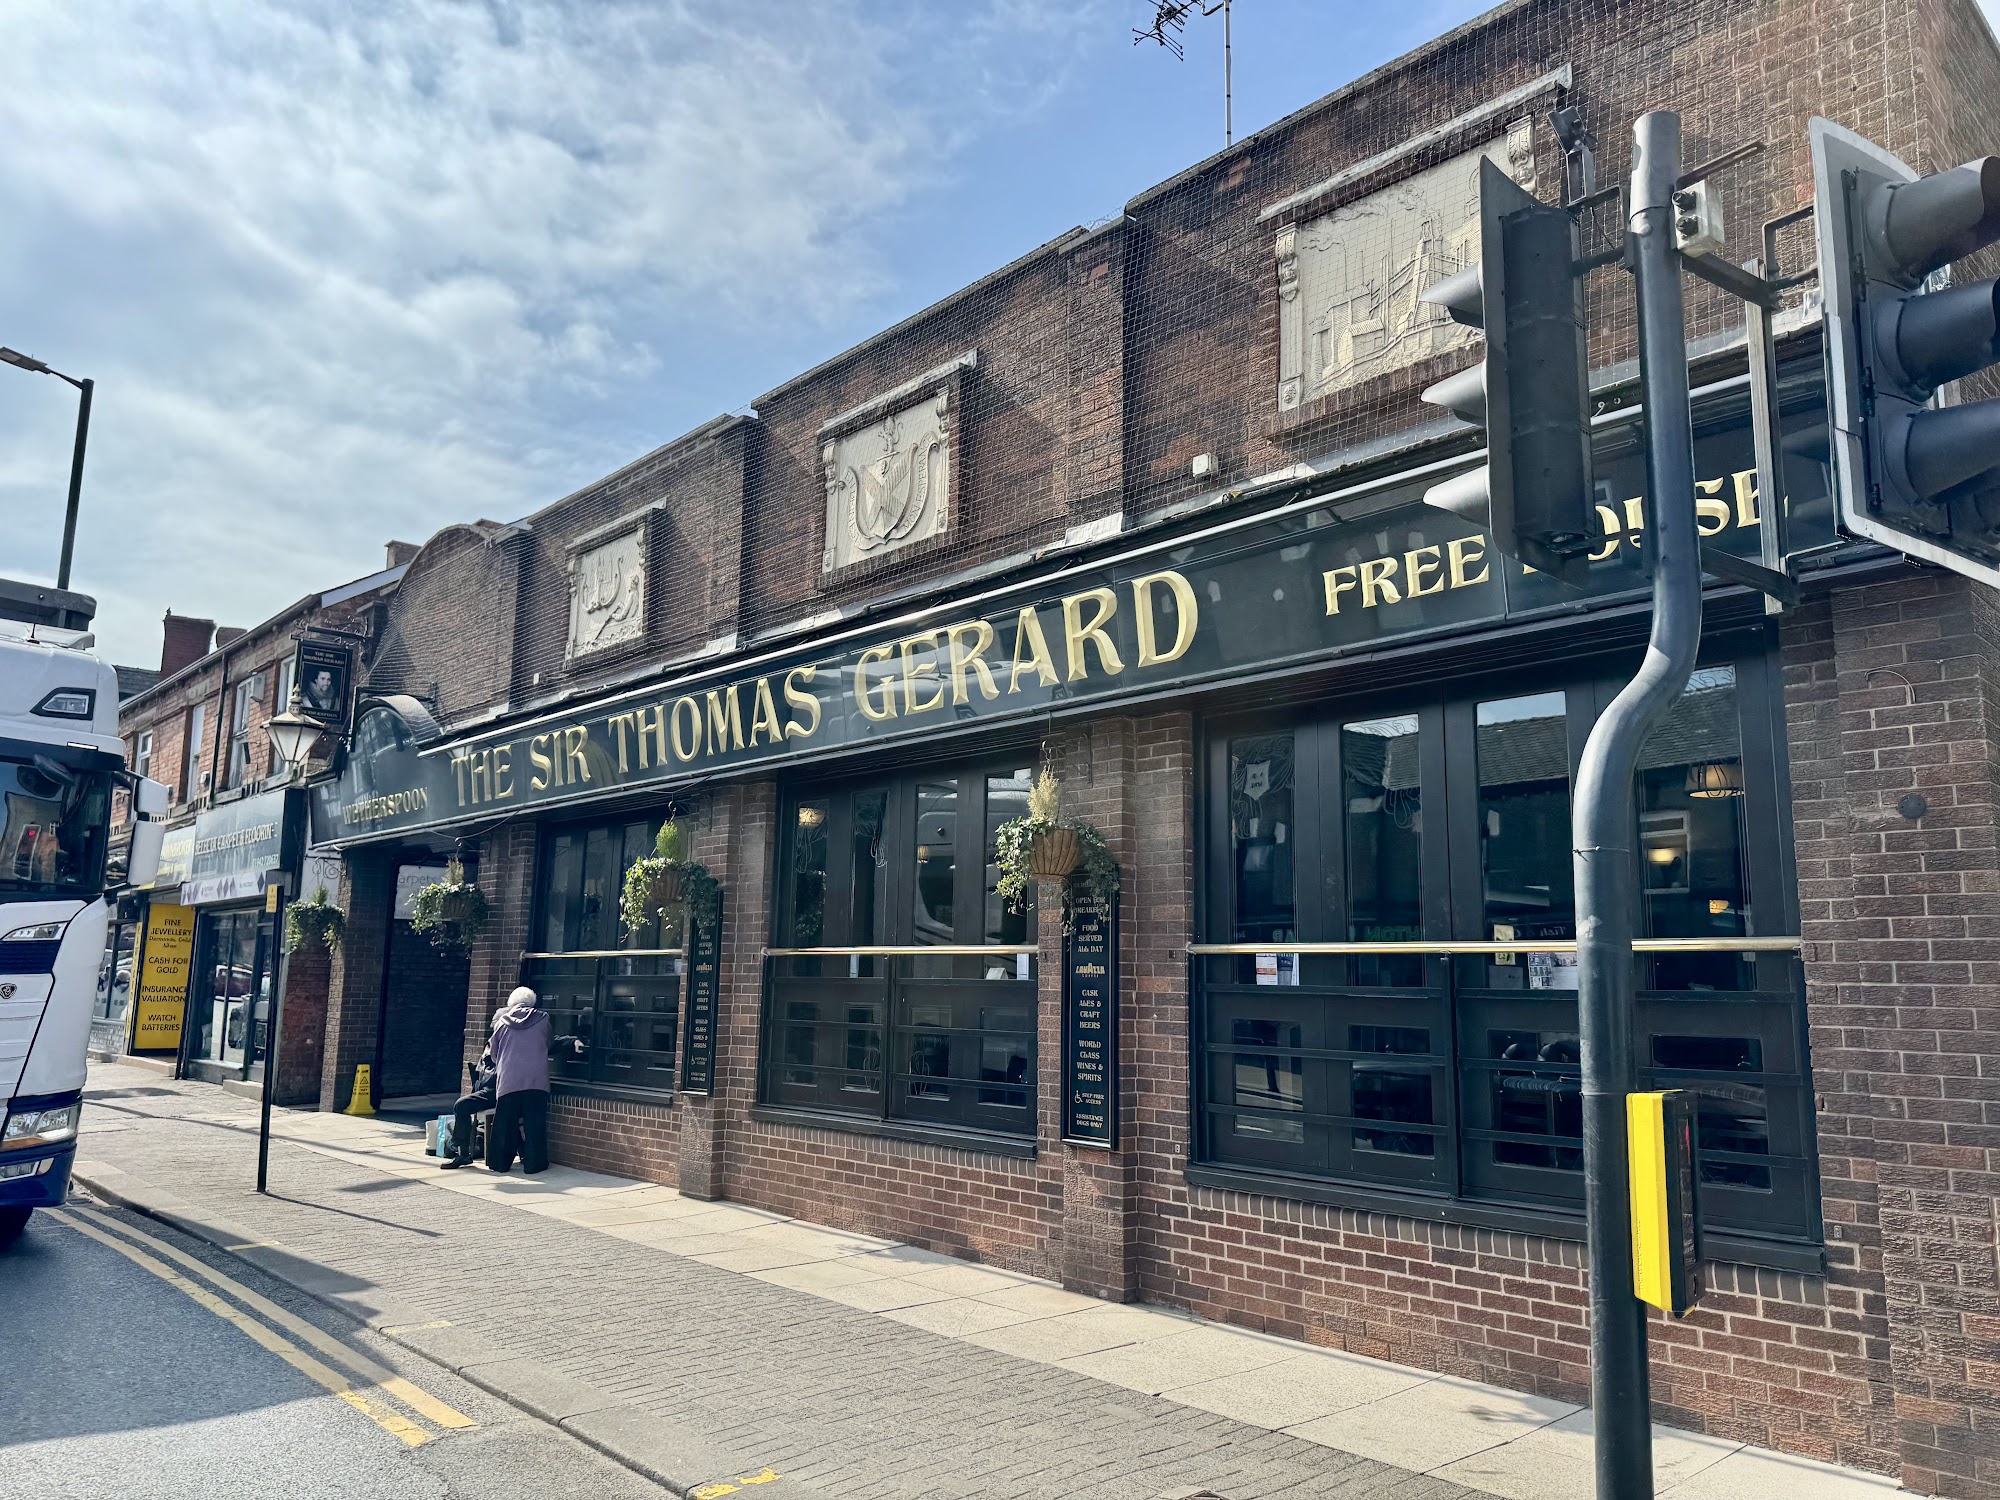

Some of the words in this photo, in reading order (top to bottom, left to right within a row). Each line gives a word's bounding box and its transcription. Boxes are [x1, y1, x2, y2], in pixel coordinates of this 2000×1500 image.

[1321, 533, 1491, 617] FREE
[450, 743, 515, 808] THE
[530, 724, 592, 792] SIR
[607, 665, 822, 774] THOMAS
[853, 569, 1199, 722] GERARD
[342, 786, 428, 825] WETHERSPOON
[150, 927, 192, 936] JEWELLERY
[1081, 924, 1099, 932] FOOD
[1078, 934, 1103, 942] SERVED
[1090, 945, 1104, 953] DAY
[148, 956, 171, 965] CASH
[172, 957, 189, 965] FOR
[156, 966, 179, 974] GOLD
[1081, 989, 1099, 997] CASK
[147, 1014, 176, 1022] WATCH
[1079, 1010, 1101, 1019] CRAFT
[141, 1023, 180, 1031] BATTERIES
[1079, 1021, 1101, 1029] BEERS
[1078, 1039, 1102, 1049] WORLD
[1079, 1051, 1100, 1060] CLASS
[1076, 1061, 1097, 1071] WINES
[1098, 1063, 1103, 1071] &
[1077, 1072, 1102, 1082] SPIRITS
